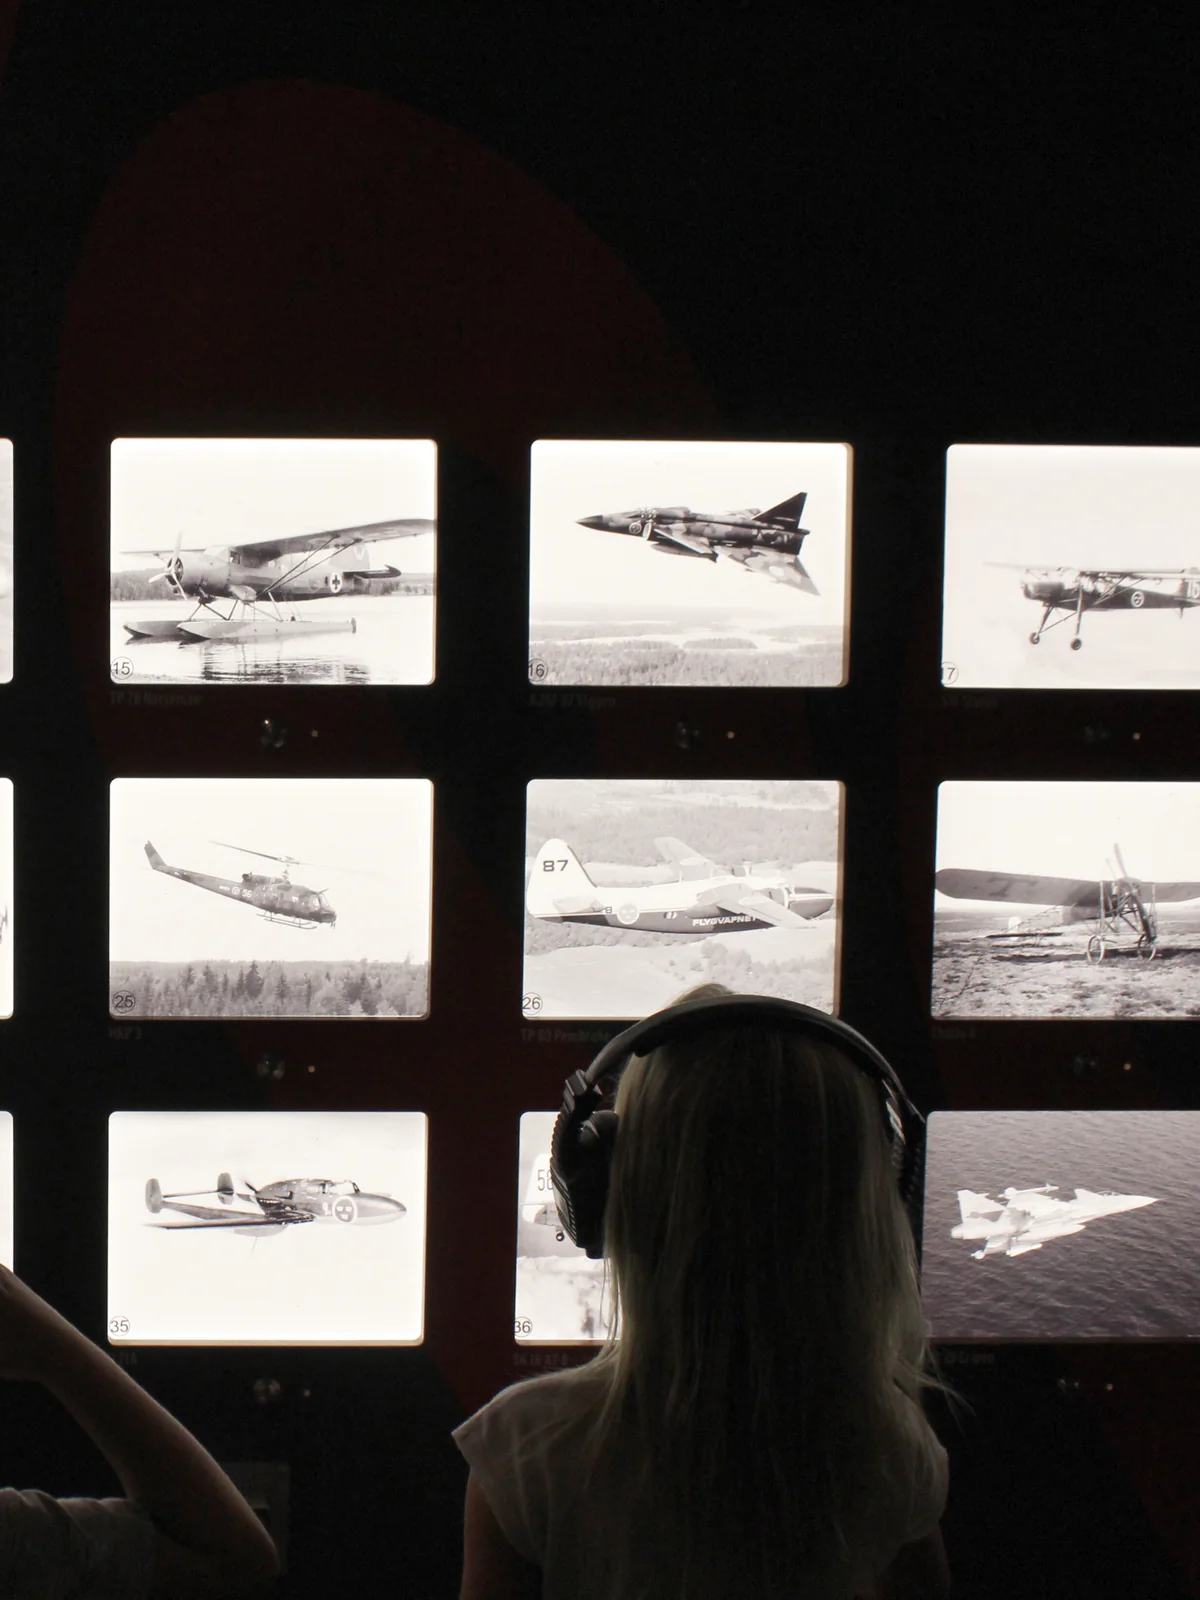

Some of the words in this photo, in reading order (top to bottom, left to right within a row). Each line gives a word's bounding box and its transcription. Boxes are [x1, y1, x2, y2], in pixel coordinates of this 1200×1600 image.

[112, 661, 131, 676] 15
[528, 663, 545, 677] 16
[543, 859, 569, 872] 87
[114, 994, 134, 1009] 25
[522, 996, 541, 1010] 26
[110, 1320, 129, 1333] 35
[514, 1320, 531, 1334] 36
